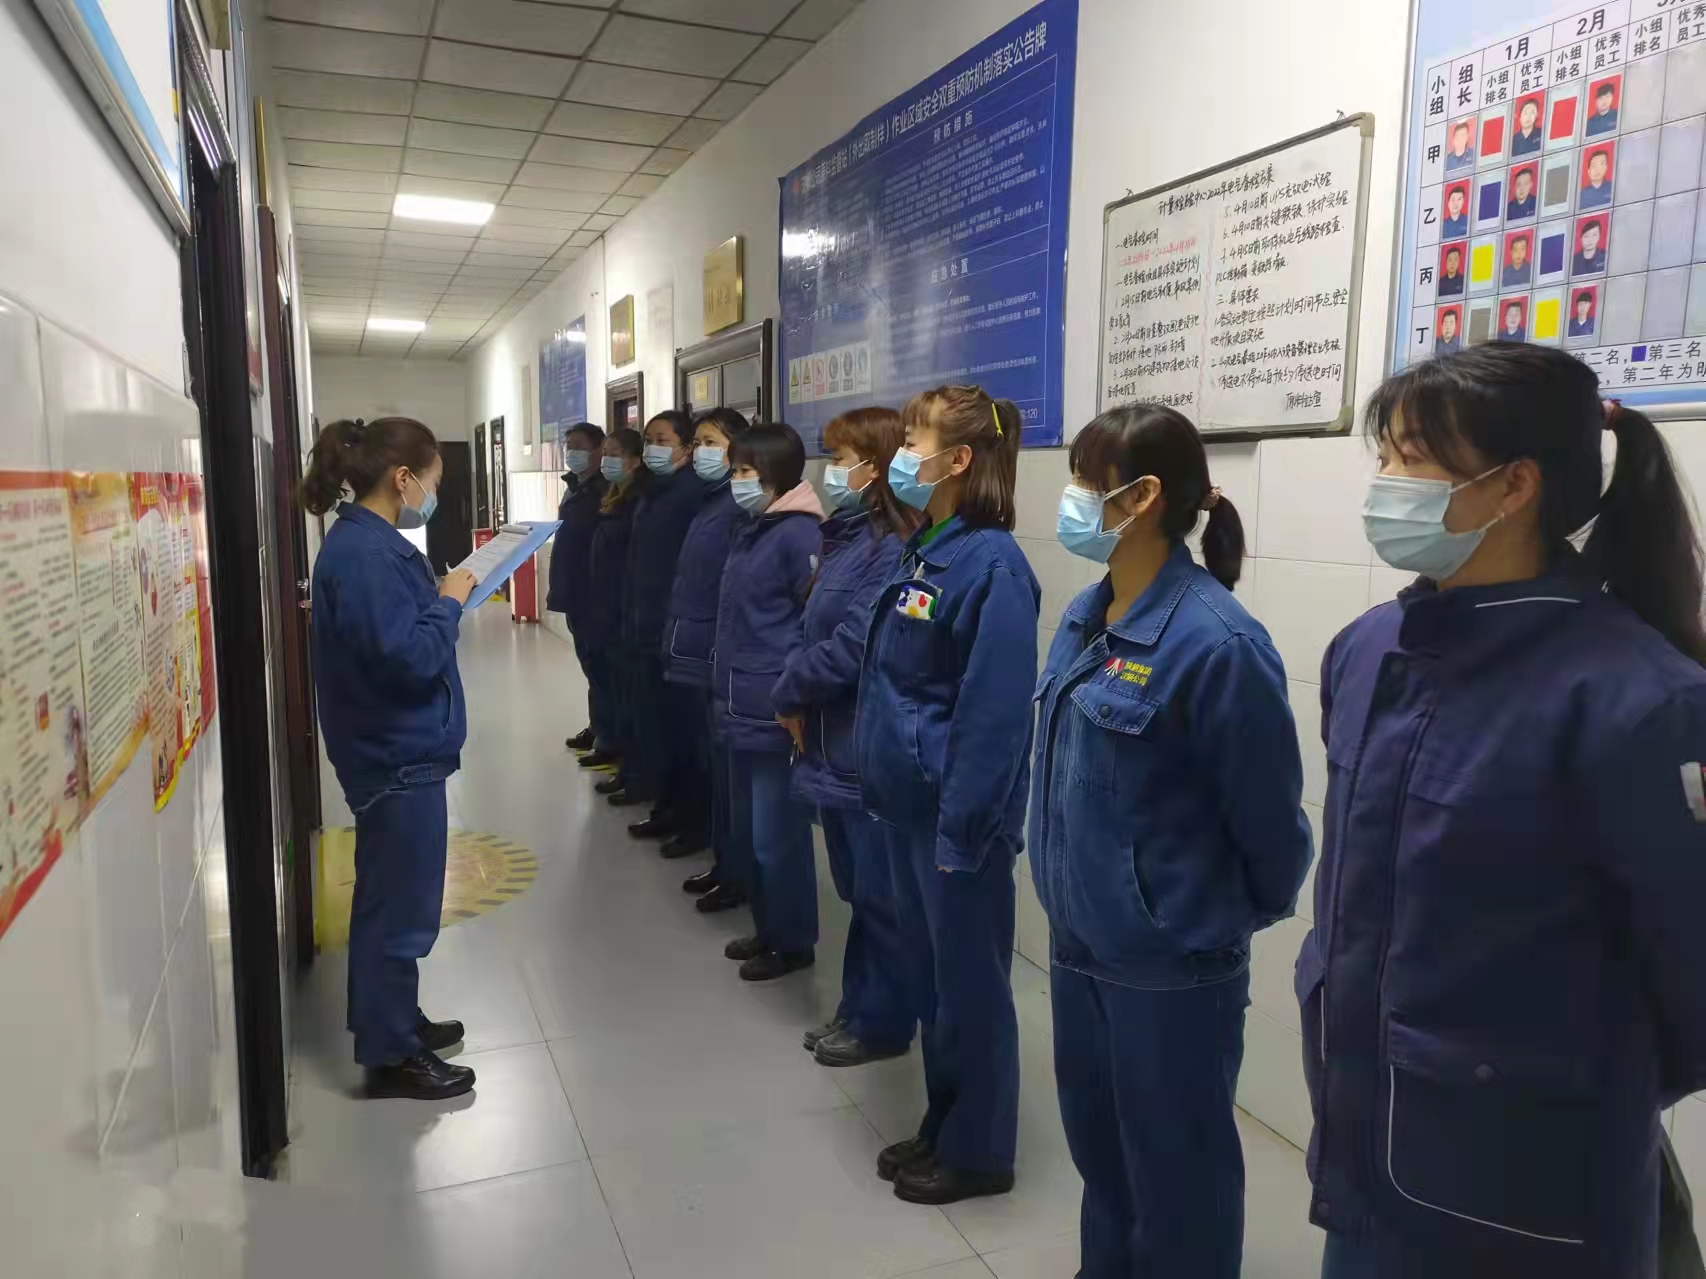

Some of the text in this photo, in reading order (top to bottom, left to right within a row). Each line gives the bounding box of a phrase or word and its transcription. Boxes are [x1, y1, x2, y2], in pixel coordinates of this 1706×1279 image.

[1576, 9, 1606, 36] 2月
[1677, 3, 1706, 25] 优秀
[1635, 16, 1664, 39] 小组
[1676, 22, 1705, 43] 员工
[1505, 36, 1530, 61] 1月
[1594, 32, 1622, 53] 优秀
[1633, 34, 1661, 54] 排名
[1556, 45, 1583, 64] 小组
[1593, 50, 1621, 69] 员工
[1520, 55, 1545, 77] 优秀
[1555, 62, 1580, 81] 排名
[1456, 63, 1474, 108] 组长
[1485, 72, 1510, 89] 小组
[1519, 75, 1545, 94] 员工
[1429, 75, 1447, 117] 小组
[1485, 87, 1508, 105] 排名
[932, 110, 974, 144] 预防措施
[1427, 144, 1441, 165] 甲
[1423, 207, 1437, 225] 乙
[1419, 266, 1434, 286] 丙
[1415, 326, 1430, 345] 丁
[1648, 341, 1701, 362] 第三名
